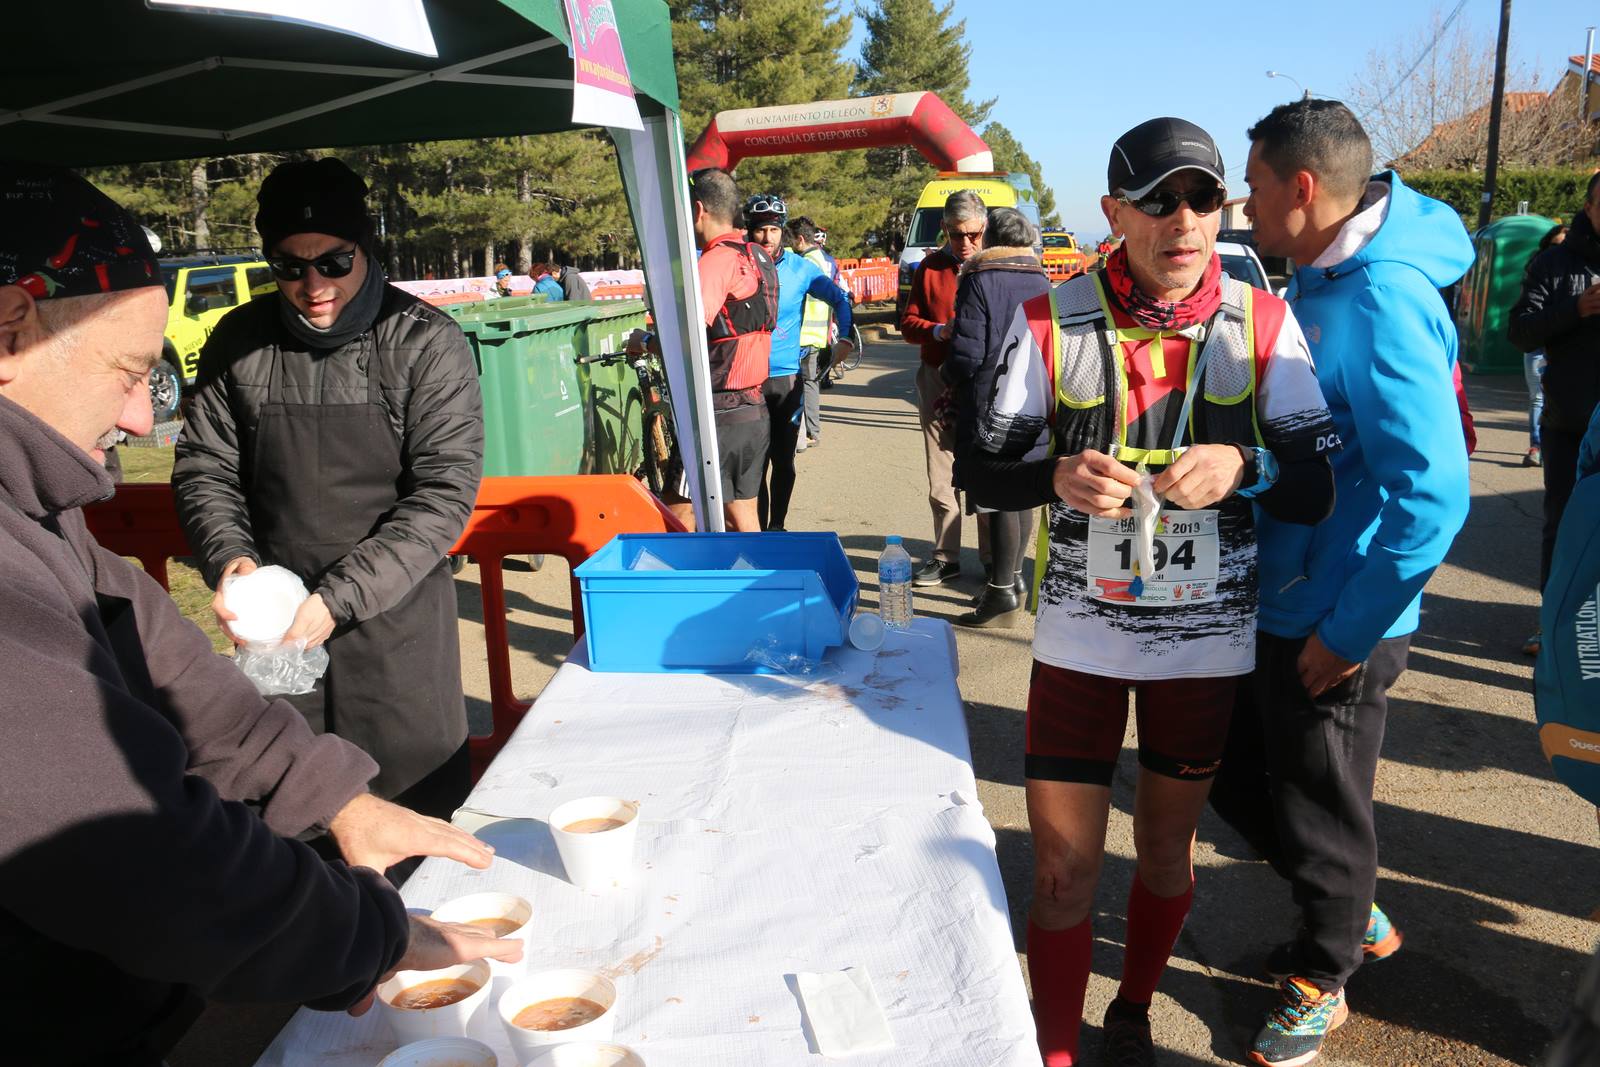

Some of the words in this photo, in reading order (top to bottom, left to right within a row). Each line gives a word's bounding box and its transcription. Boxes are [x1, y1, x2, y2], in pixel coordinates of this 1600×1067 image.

[744, 111, 821, 125] AYUNTAMIENTO
[823, 110, 836, 119] DE
[802, 132, 816, 142] DE
[818, 127, 868, 141] DEPORTES
[1172, 521, 1201, 534] 2019
